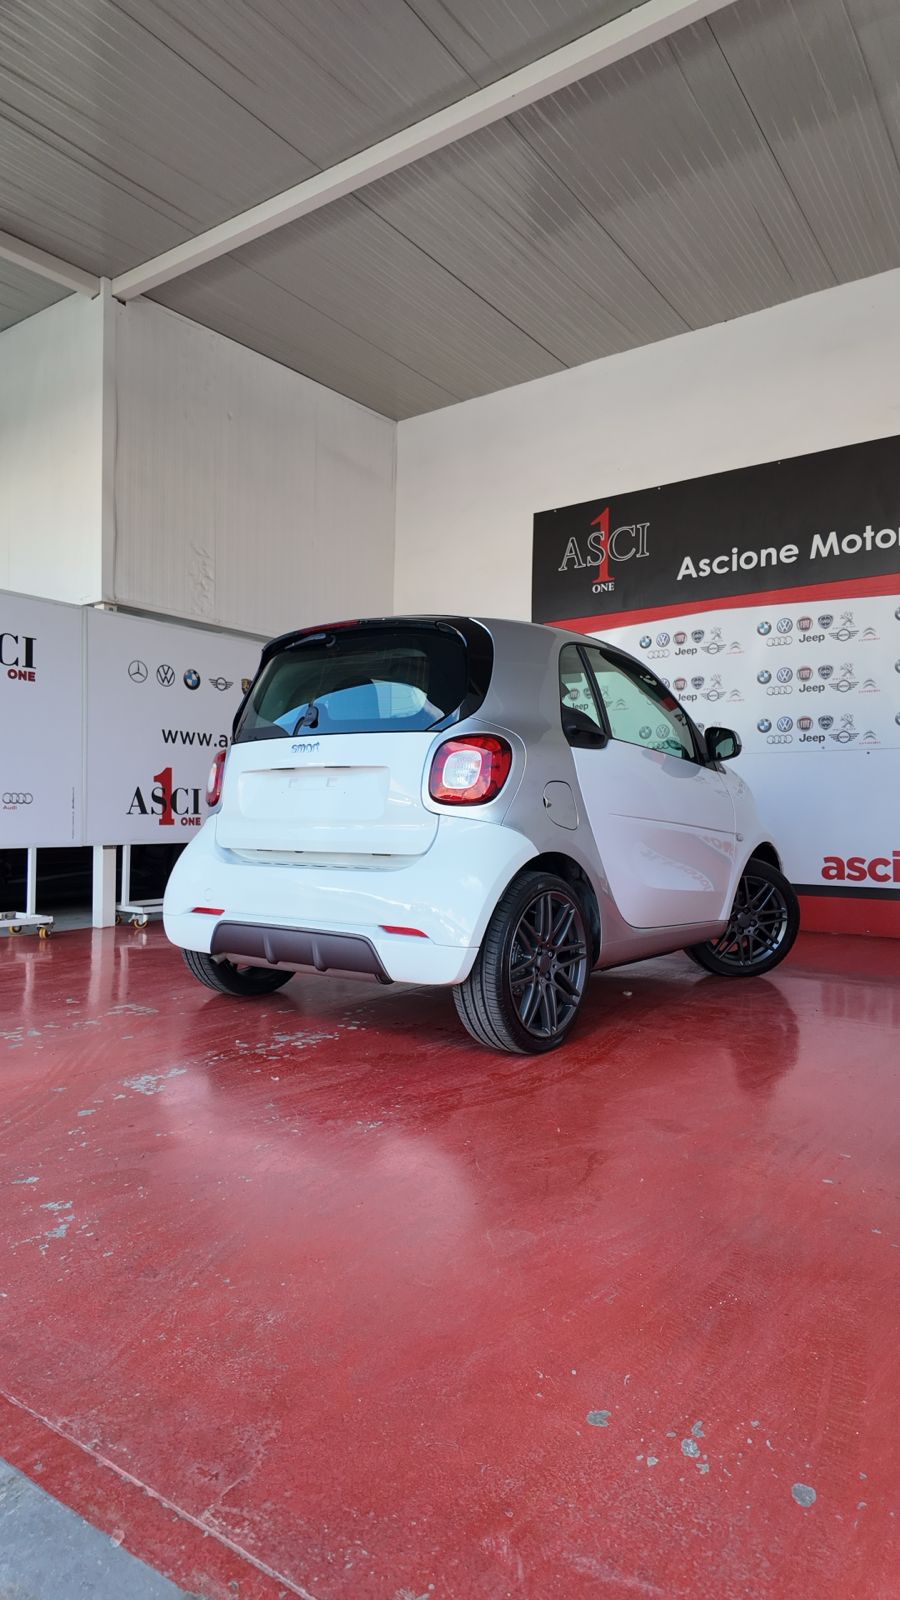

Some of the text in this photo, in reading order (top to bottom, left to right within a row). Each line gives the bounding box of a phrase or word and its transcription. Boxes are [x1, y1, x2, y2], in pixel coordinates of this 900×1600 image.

[677, 525, 900, 580] Ascione Moto
[592, 582, 615, 593] ONE
[798, 634, 825, 643] Jeep
[675, 647, 698, 656] Jeep
[7, 669, 36, 682] ONE
[798, 684, 825, 693] Jeep
[162, 729, 234, 748] www.a
[798, 733, 826, 743] Jeep
[291, 741, 320, 753] smart
[126, 786, 202, 815] ASCI
[180, 817, 201, 826] ONE
[821, 850, 900, 883] asci
